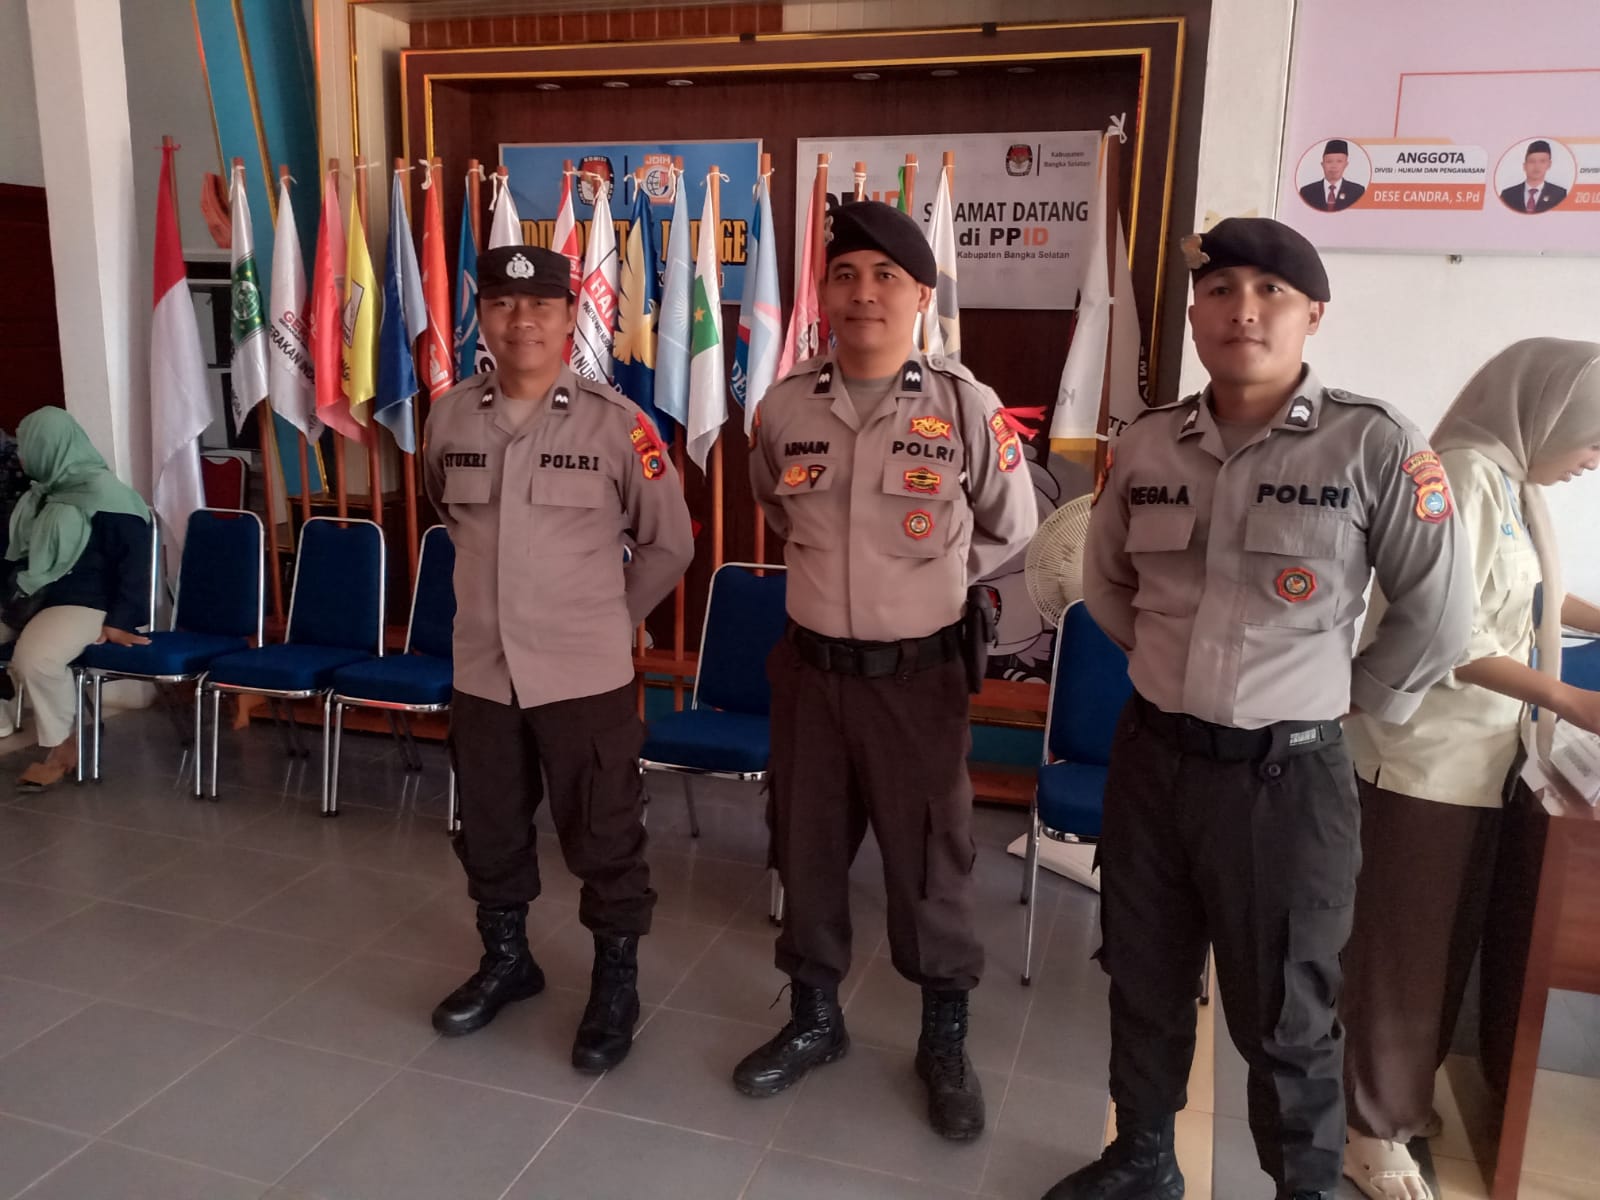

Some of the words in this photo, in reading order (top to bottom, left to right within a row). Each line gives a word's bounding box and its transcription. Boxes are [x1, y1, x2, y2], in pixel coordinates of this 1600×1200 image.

[1396, 152, 1465, 164] ANGGOTA
[1374, 191, 1401, 202] DESE
[1403, 191, 1453, 204] CANDRA,
[1456, 191, 1480, 203] S.Pd
[924, 202, 1006, 222] SAMAT
[1013, 201, 1088, 222] DATANG
[959, 228, 980, 246] di
[990, 228, 1049, 246] PPID
[957, 251, 1002, 261] Kabupaten
[1004, 251, 1036, 261] Bangka
[1038, 251, 1070, 260] Selatan
[444, 453, 487, 468] SYUKRI
[892, 440, 955, 463] POLRI
[540, 453, 600, 471] POLRI
[1131, 485, 1190, 506] REGA.A
[1257, 483, 1350, 509] POLRI
